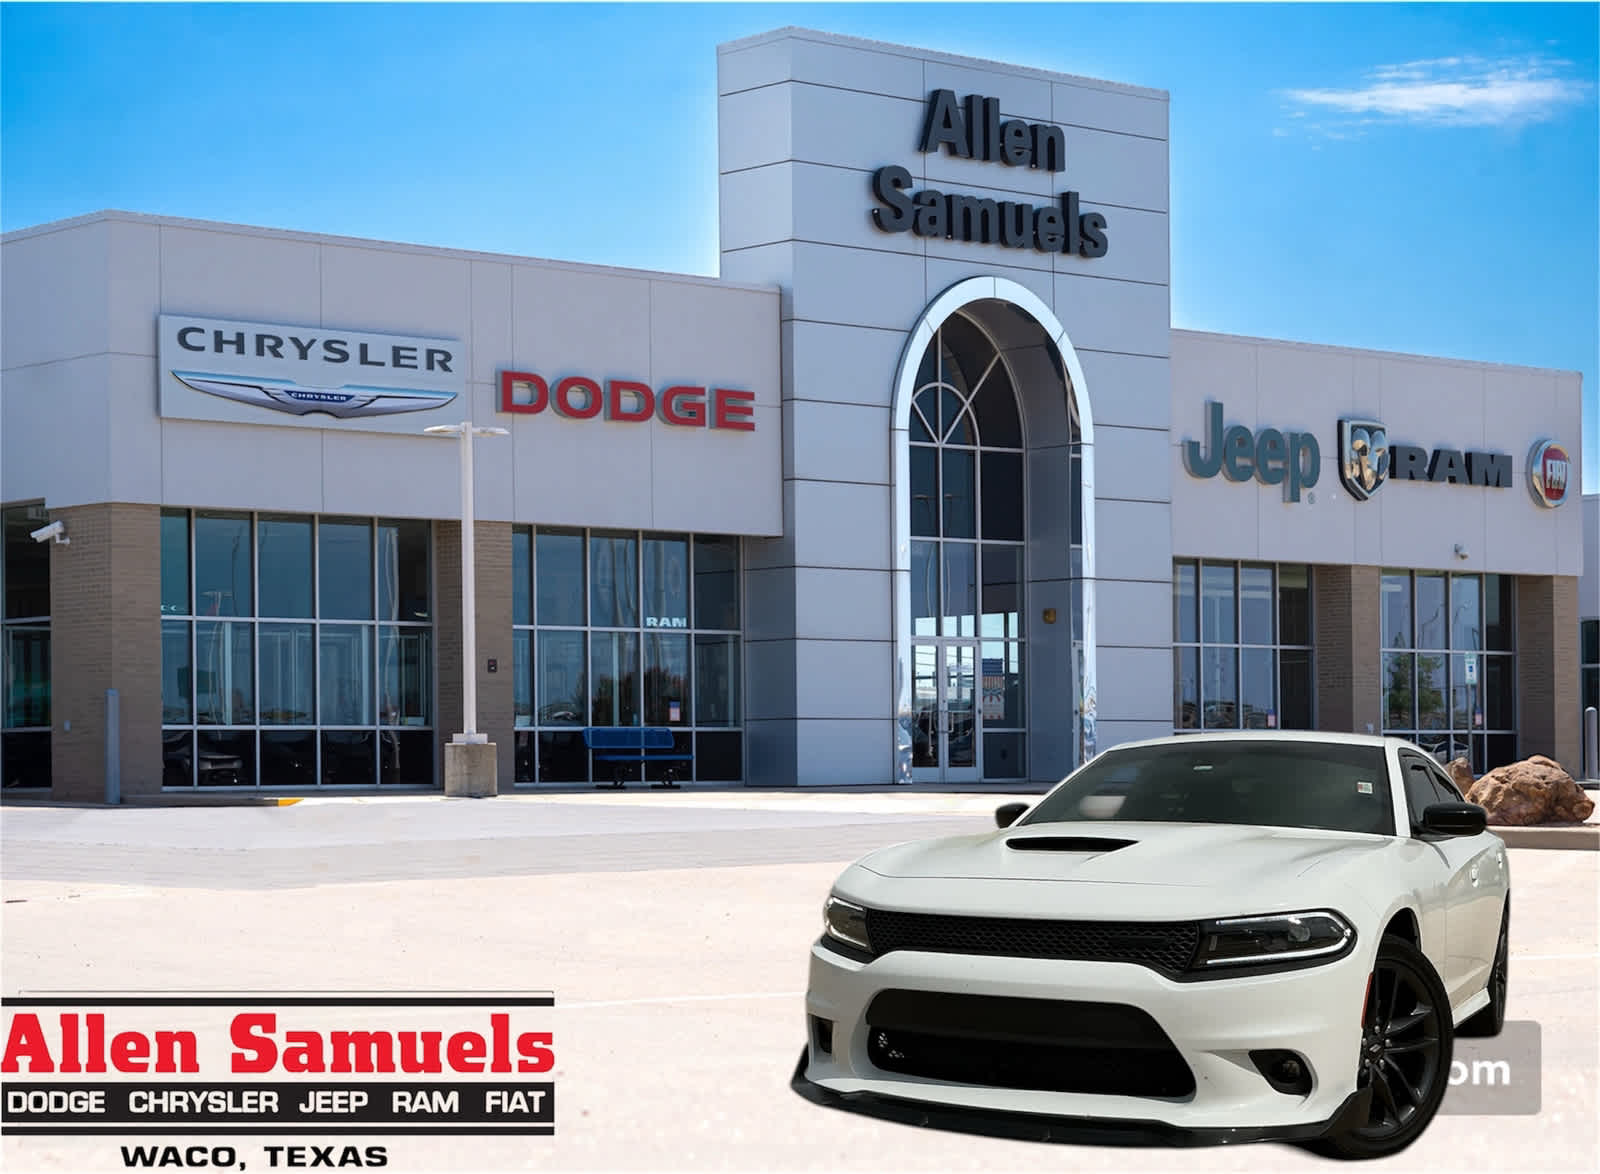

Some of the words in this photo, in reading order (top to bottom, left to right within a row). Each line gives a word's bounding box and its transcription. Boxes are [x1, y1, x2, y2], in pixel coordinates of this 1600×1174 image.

[919, 88, 1065, 172] Allen
[871, 165, 1108, 257] Samuels
[176, 326, 453, 373] CHRYSLER
[291, 392, 347, 401] CHRYSLER
[495, 370, 755, 432] DODGE
[1182, 401, 1320, 503] Jeep
[1388, 445, 1513, 488] RAM
[646, 616, 687, 627] RAM
